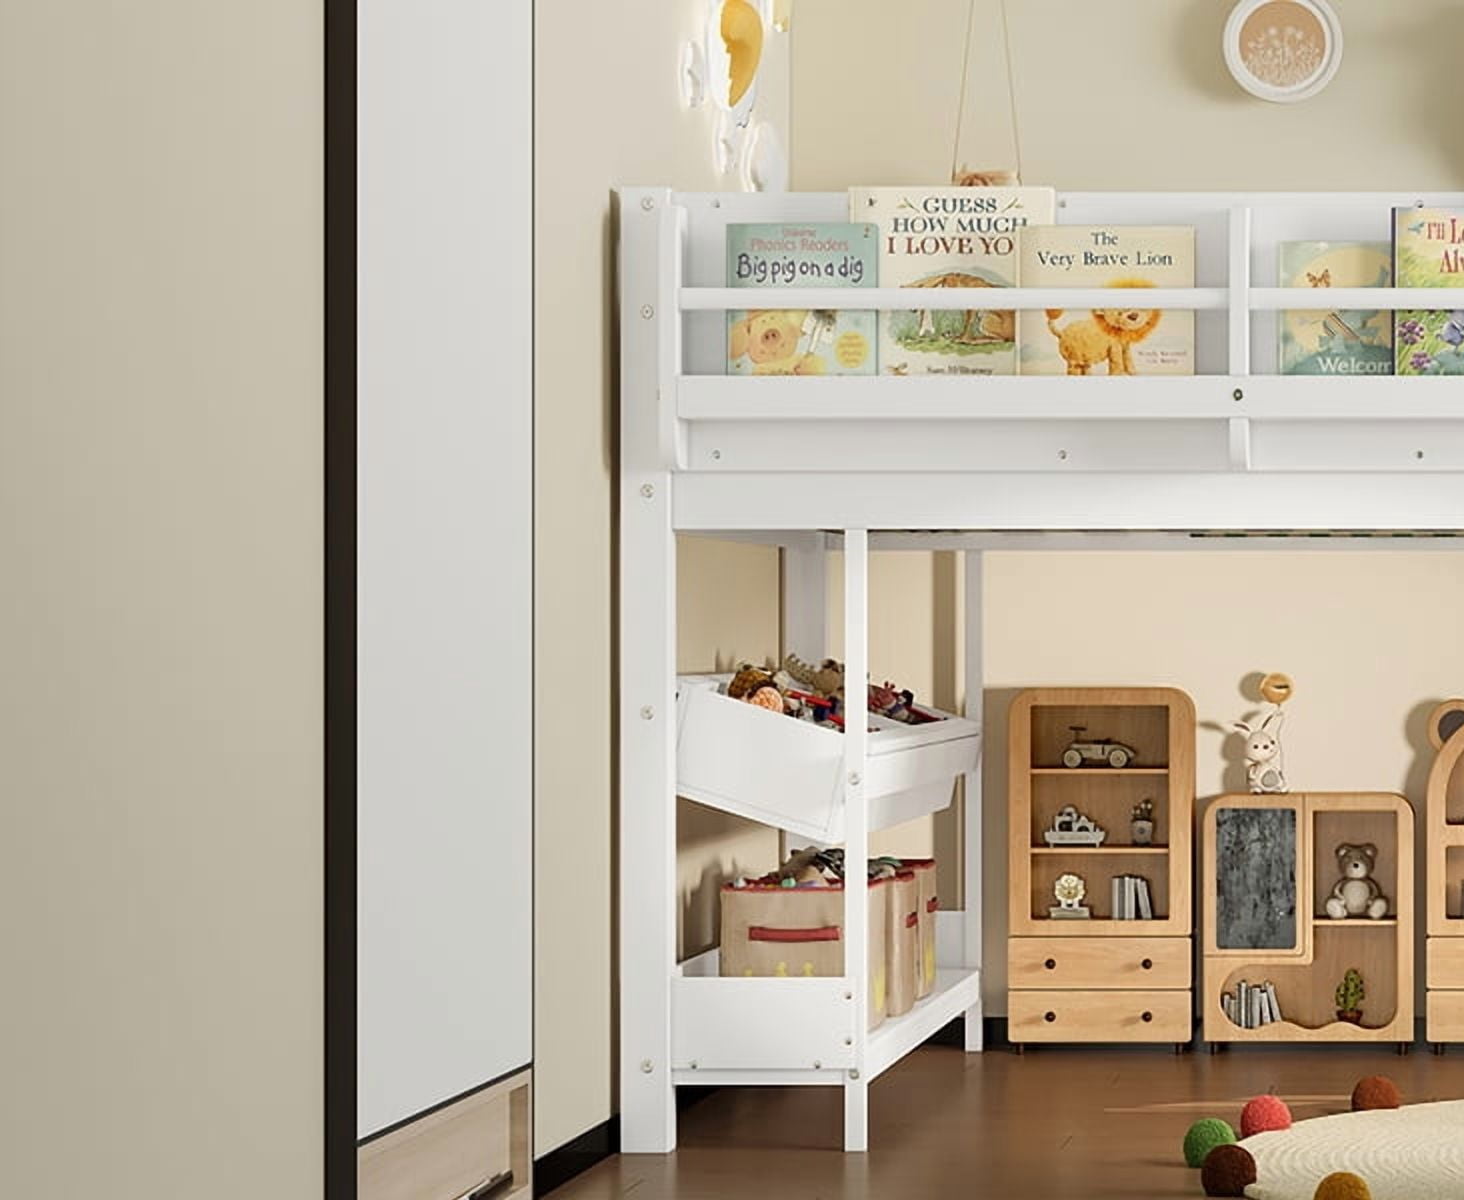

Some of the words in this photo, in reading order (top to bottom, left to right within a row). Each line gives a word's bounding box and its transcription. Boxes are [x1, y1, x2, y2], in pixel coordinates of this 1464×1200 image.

[923, 197, 997, 213] GUESS
[893, 216, 949, 233] HOW
[956, 216, 1028, 233] MUCH
[887, 236, 896, 255] I
[906, 236, 973, 255] LOVE
[979, 236, 1014, 256] YO
[1091, 231, 1119, 245] The
[736, 252, 767, 283] Big
[771, 256, 796, 283] pig
[799, 261, 821, 277] on
[824, 261, 834, 277] a
[838, 256, 863, 283] dig
[1037, 251, 1075, 270] Very
[1083, 251, 1128, 266] Brave
[1136, 251, 1173, 266] Lion
[1317, 357, 1392, 374] Welcom
